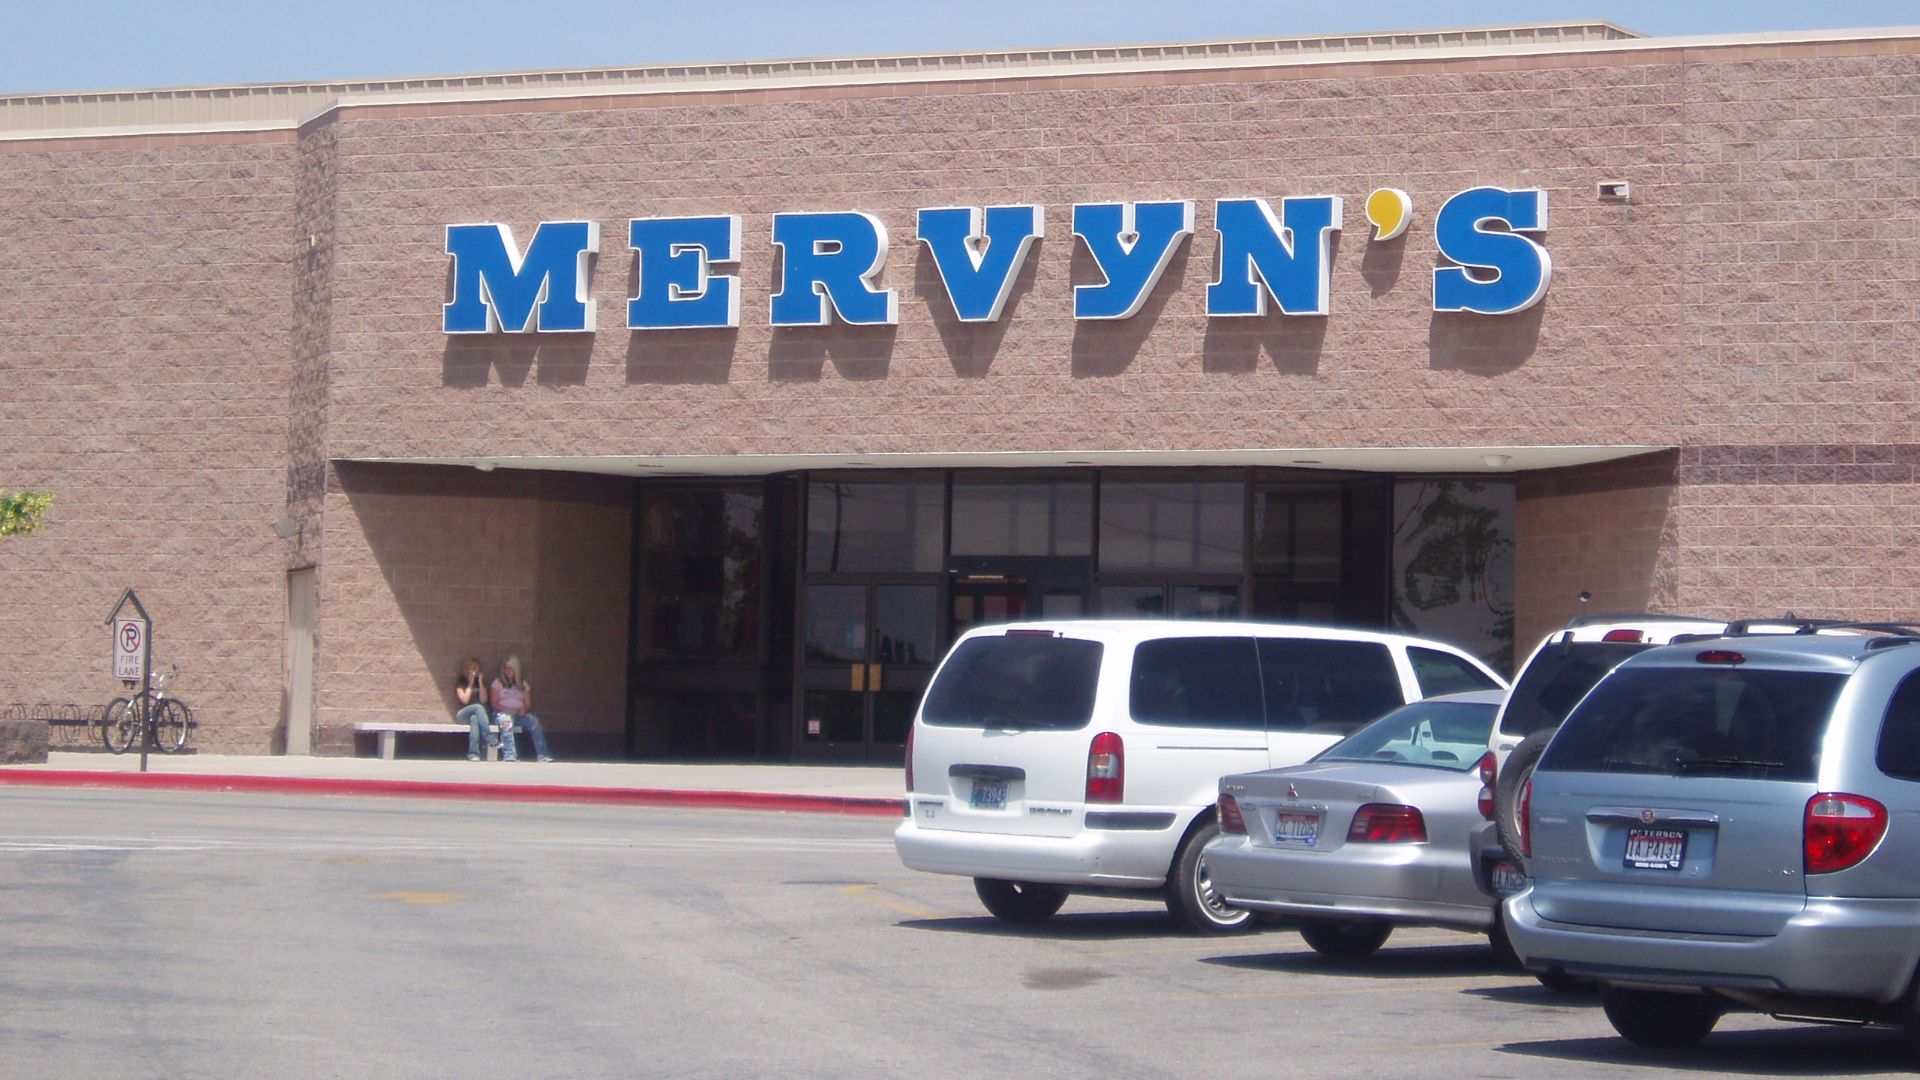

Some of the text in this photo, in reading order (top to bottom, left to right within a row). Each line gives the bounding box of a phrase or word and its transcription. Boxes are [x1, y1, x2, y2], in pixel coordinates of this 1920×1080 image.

[442, 184, 1552, 335] MERVYN'S
[120, 656, 140, 665] FIRE
[118, 667, 140, 676] LANE
